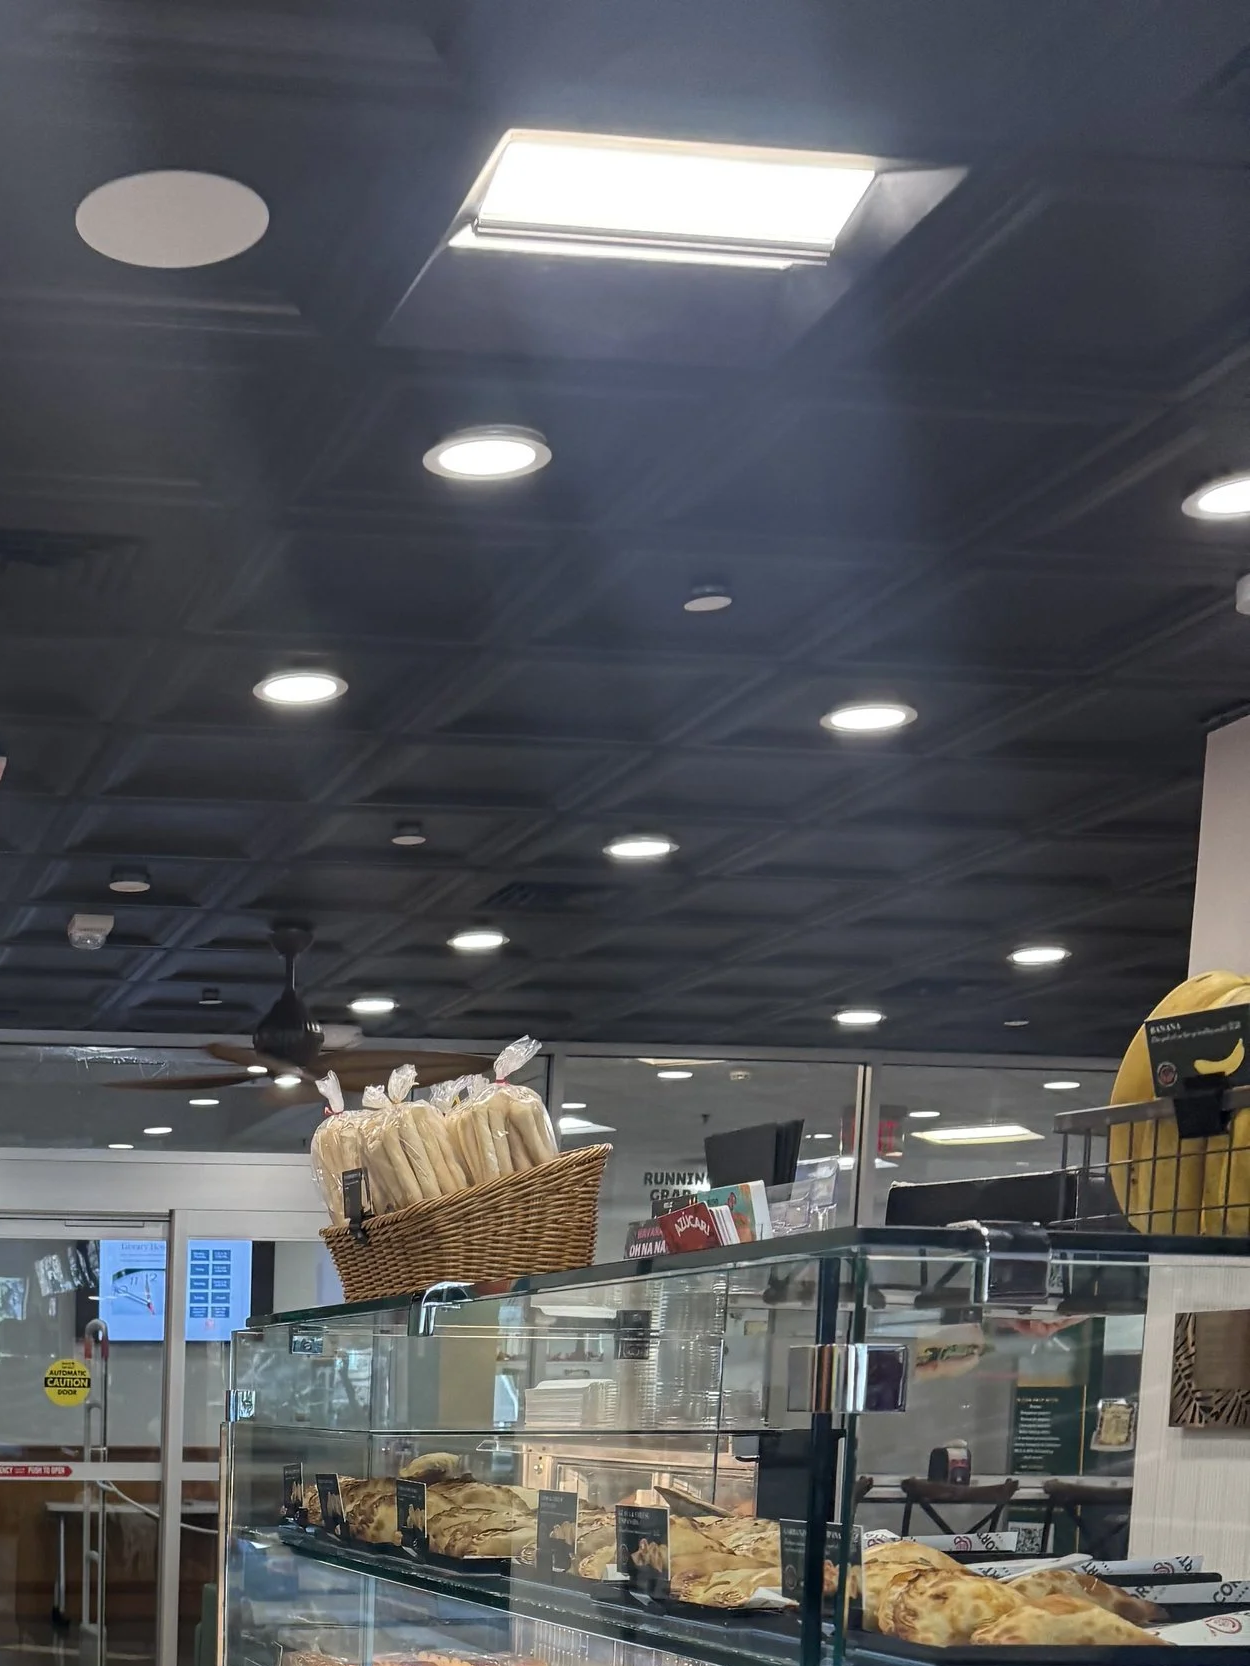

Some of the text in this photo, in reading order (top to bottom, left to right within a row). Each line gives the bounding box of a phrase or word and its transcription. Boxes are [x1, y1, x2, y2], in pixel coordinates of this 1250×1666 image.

[644, 1171, 705, 1186] RUNNIN
[629, 1243, 641, 1257] OH
[47, 1377, 88, 1387] CAUTION
